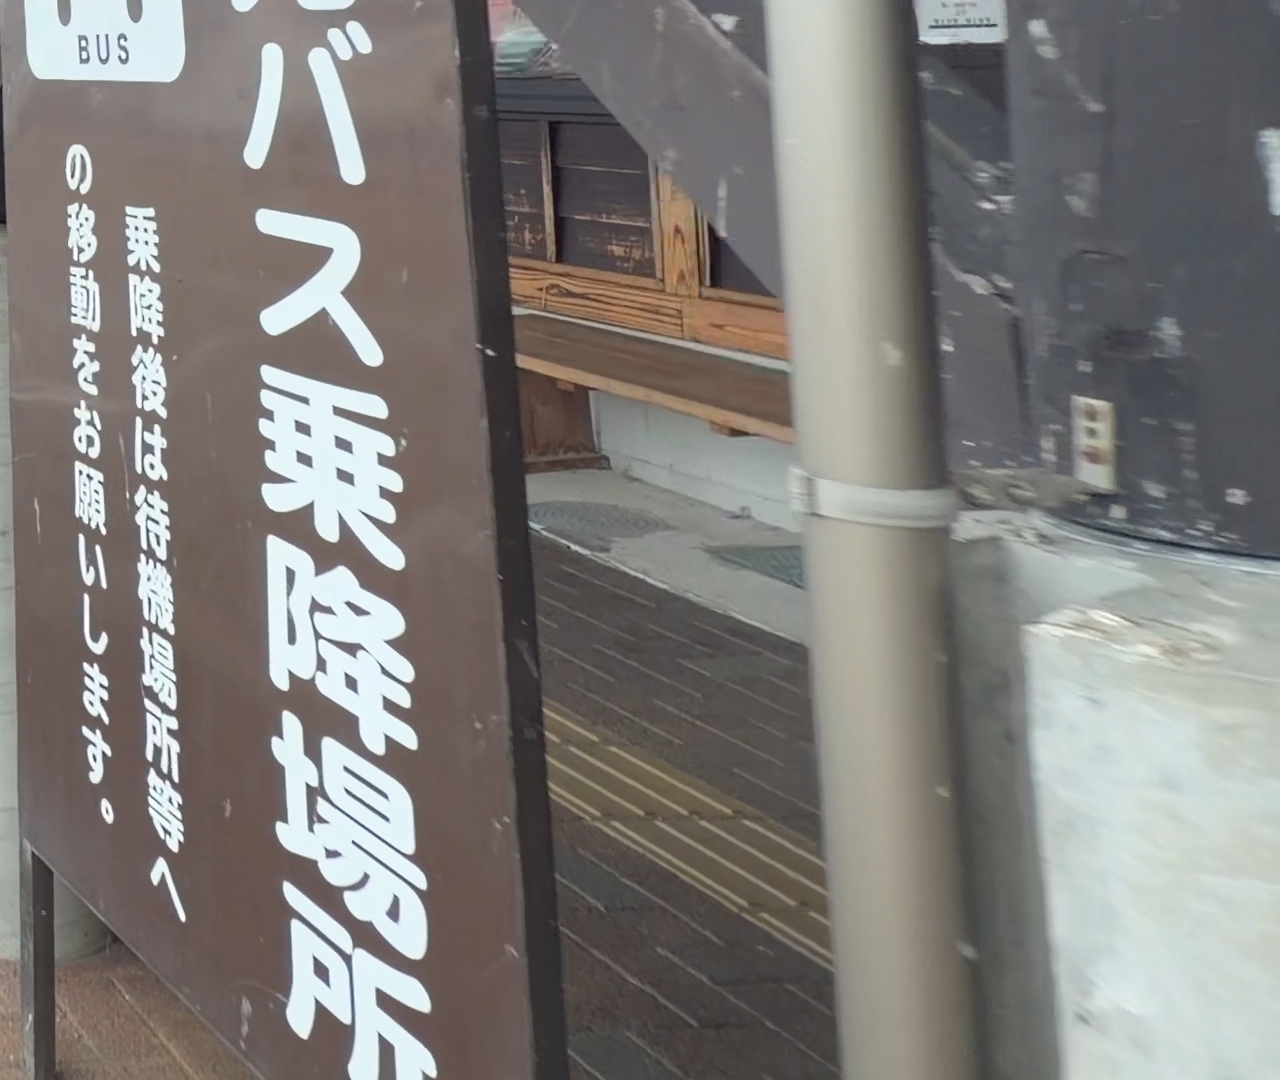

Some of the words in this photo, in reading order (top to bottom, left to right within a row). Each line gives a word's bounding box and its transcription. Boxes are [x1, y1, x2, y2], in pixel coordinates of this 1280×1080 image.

[78, 33, 130, 65] BUS
[65, 144, 114, 824] の移動をお願いします。
[125, 205, 186, 923] 乗降後は待機場所等へ
